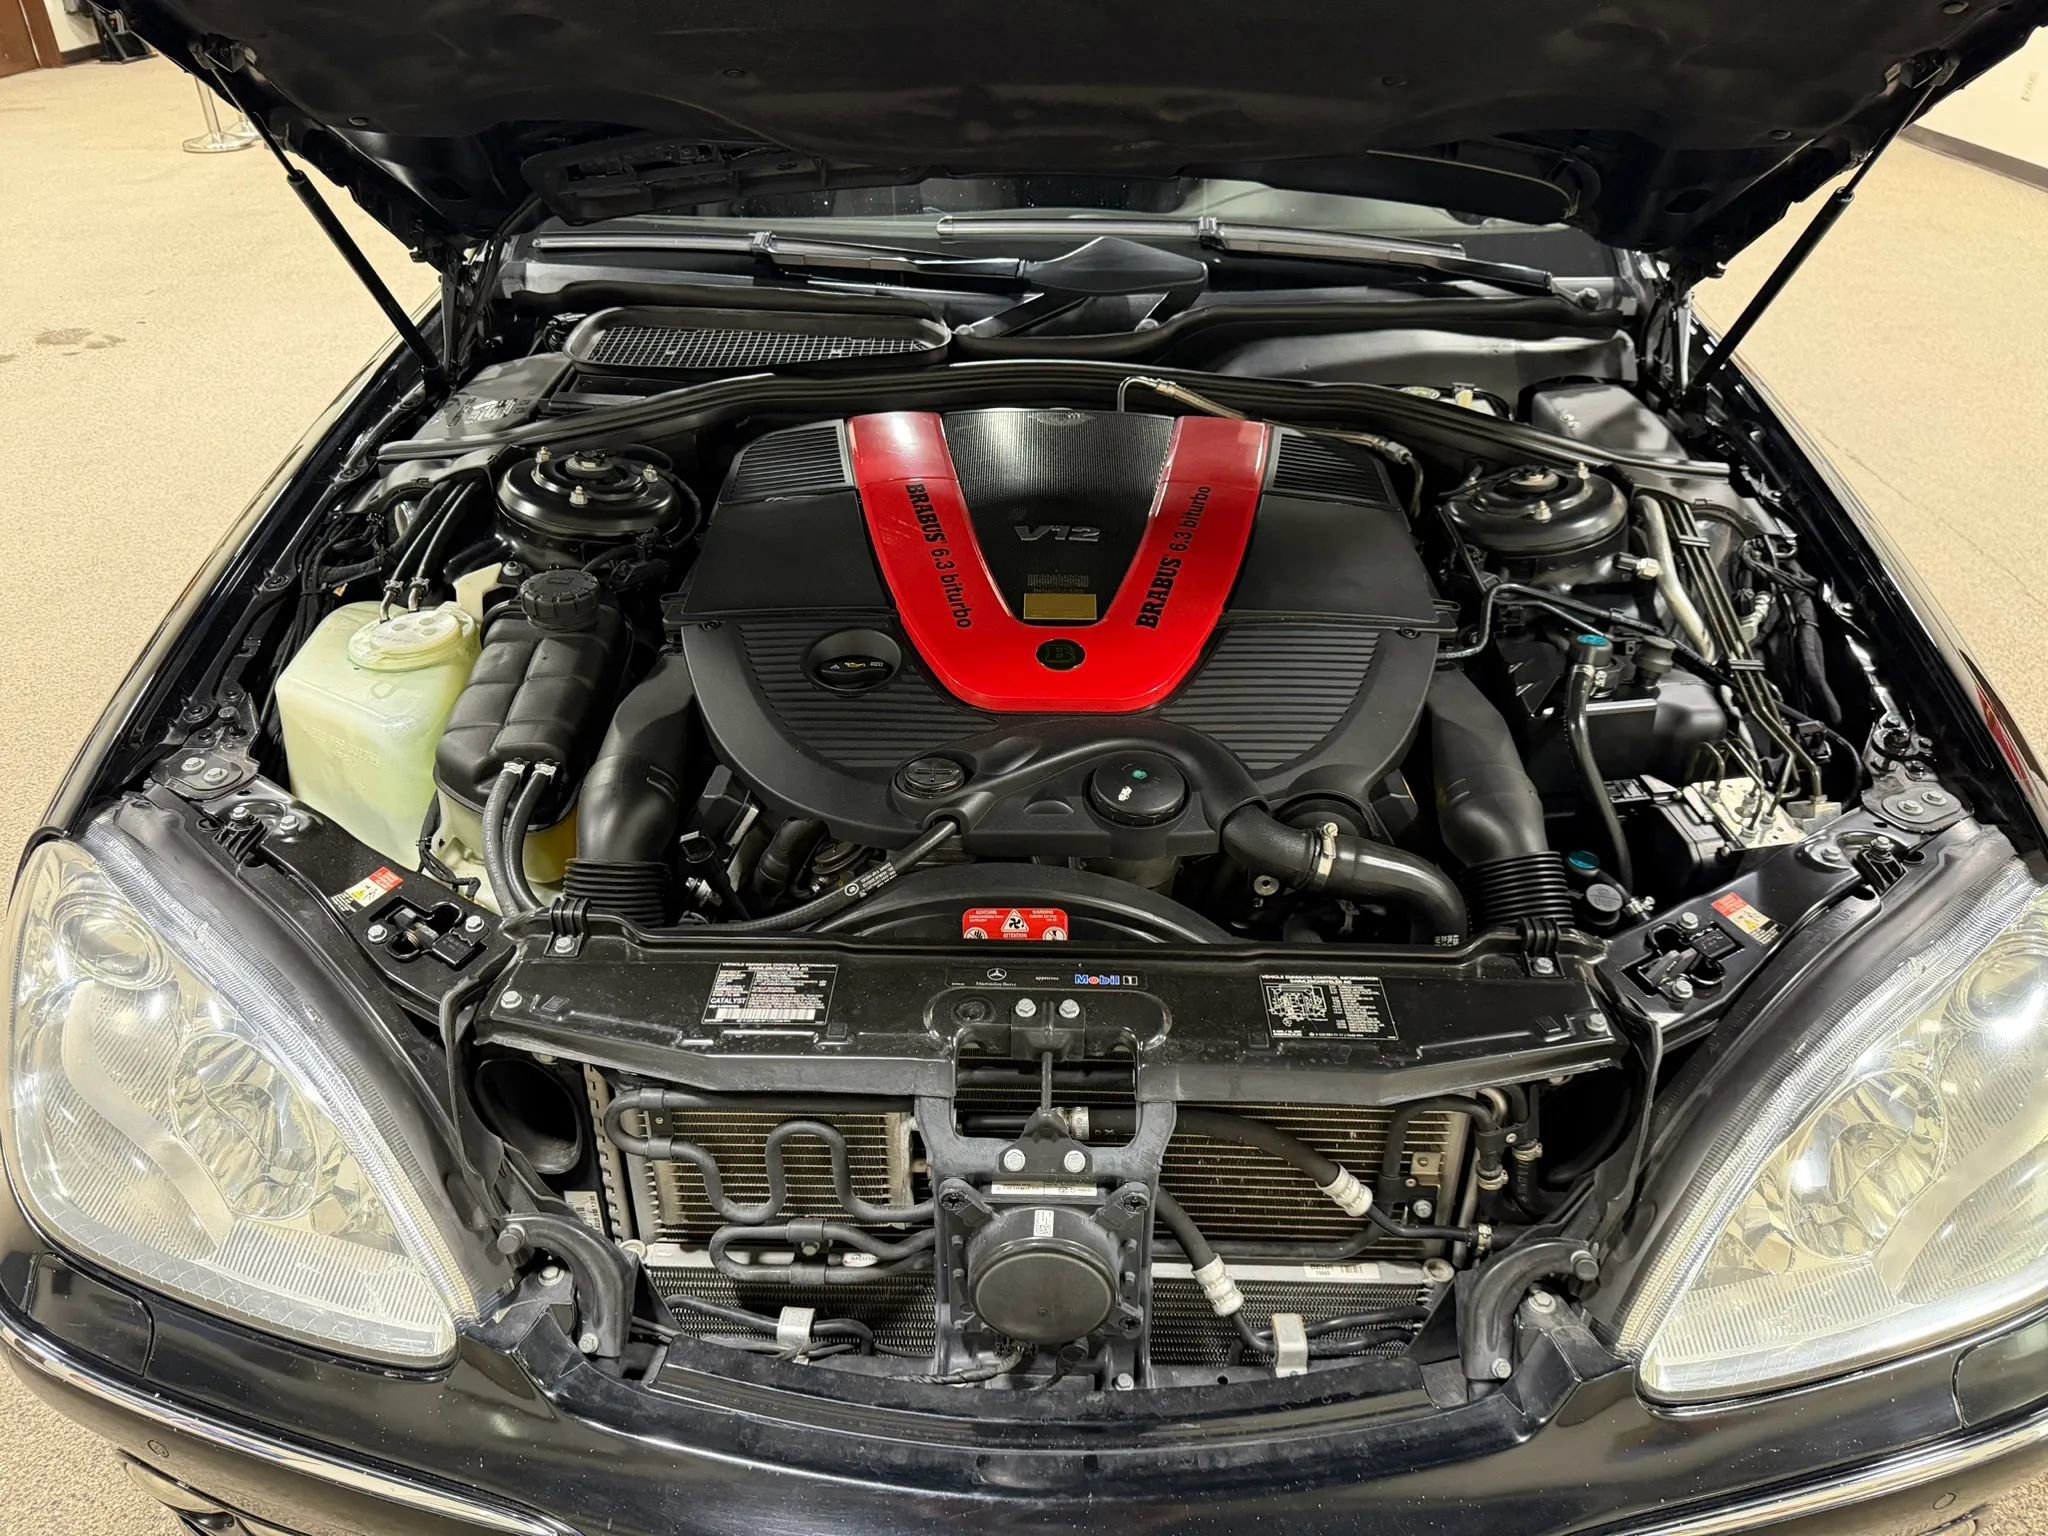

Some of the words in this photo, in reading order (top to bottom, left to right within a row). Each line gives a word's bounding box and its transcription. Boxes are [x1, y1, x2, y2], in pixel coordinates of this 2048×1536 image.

[905, 483, 946, 543] BRABUS
[1179, 486, 1212, 529] biturbo
[1014, 525, 1100, 541] V12
[1169, 531, 1192, 552] 6.3
[931, 548, 955, 570] 6.3
[940, 573, 972, 628] biturbo
[1135, 556, 1182, 629] BRABUS
[1074, 974, 1120, 985] Mobil
